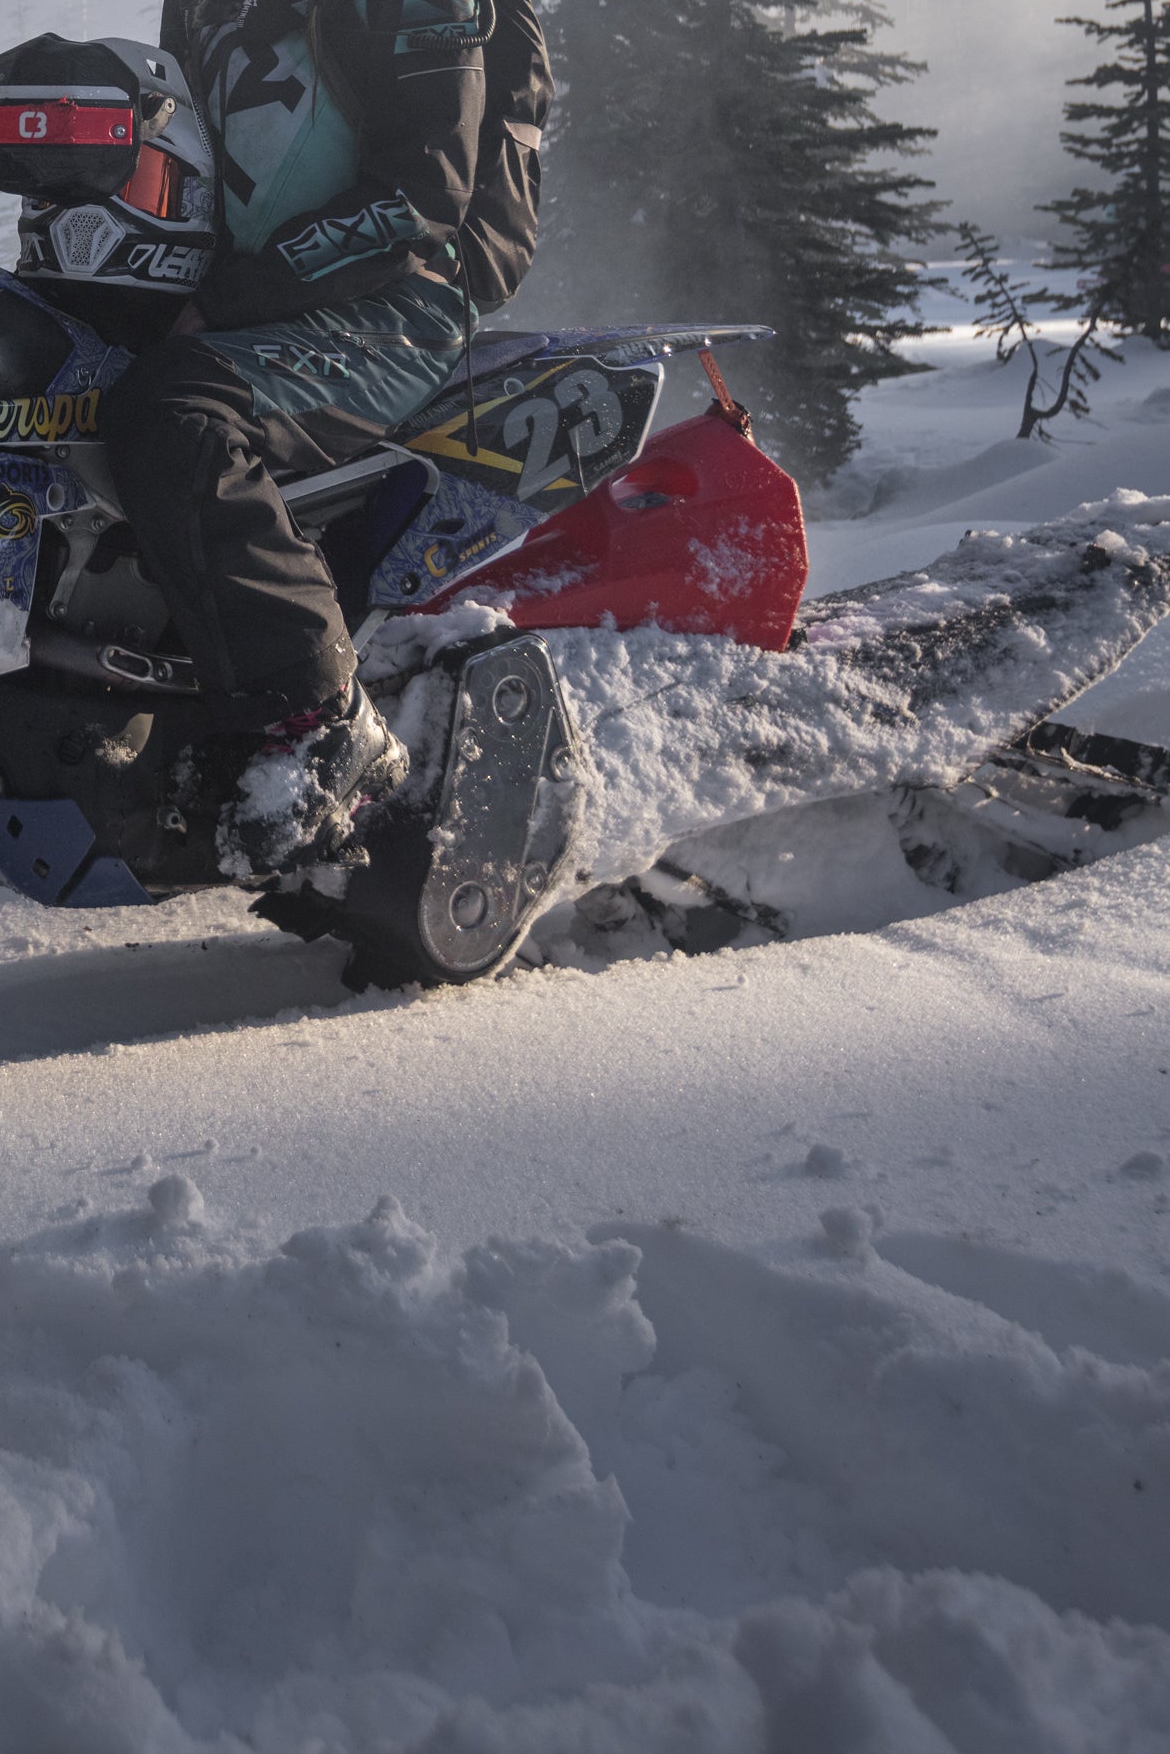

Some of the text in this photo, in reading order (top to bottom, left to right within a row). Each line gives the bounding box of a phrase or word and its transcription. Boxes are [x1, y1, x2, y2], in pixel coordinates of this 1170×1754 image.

[251, 345, 350, 379] FXR
[503, 368, 622, 503] 23
[458, 532, 499, 564] SPORTS
